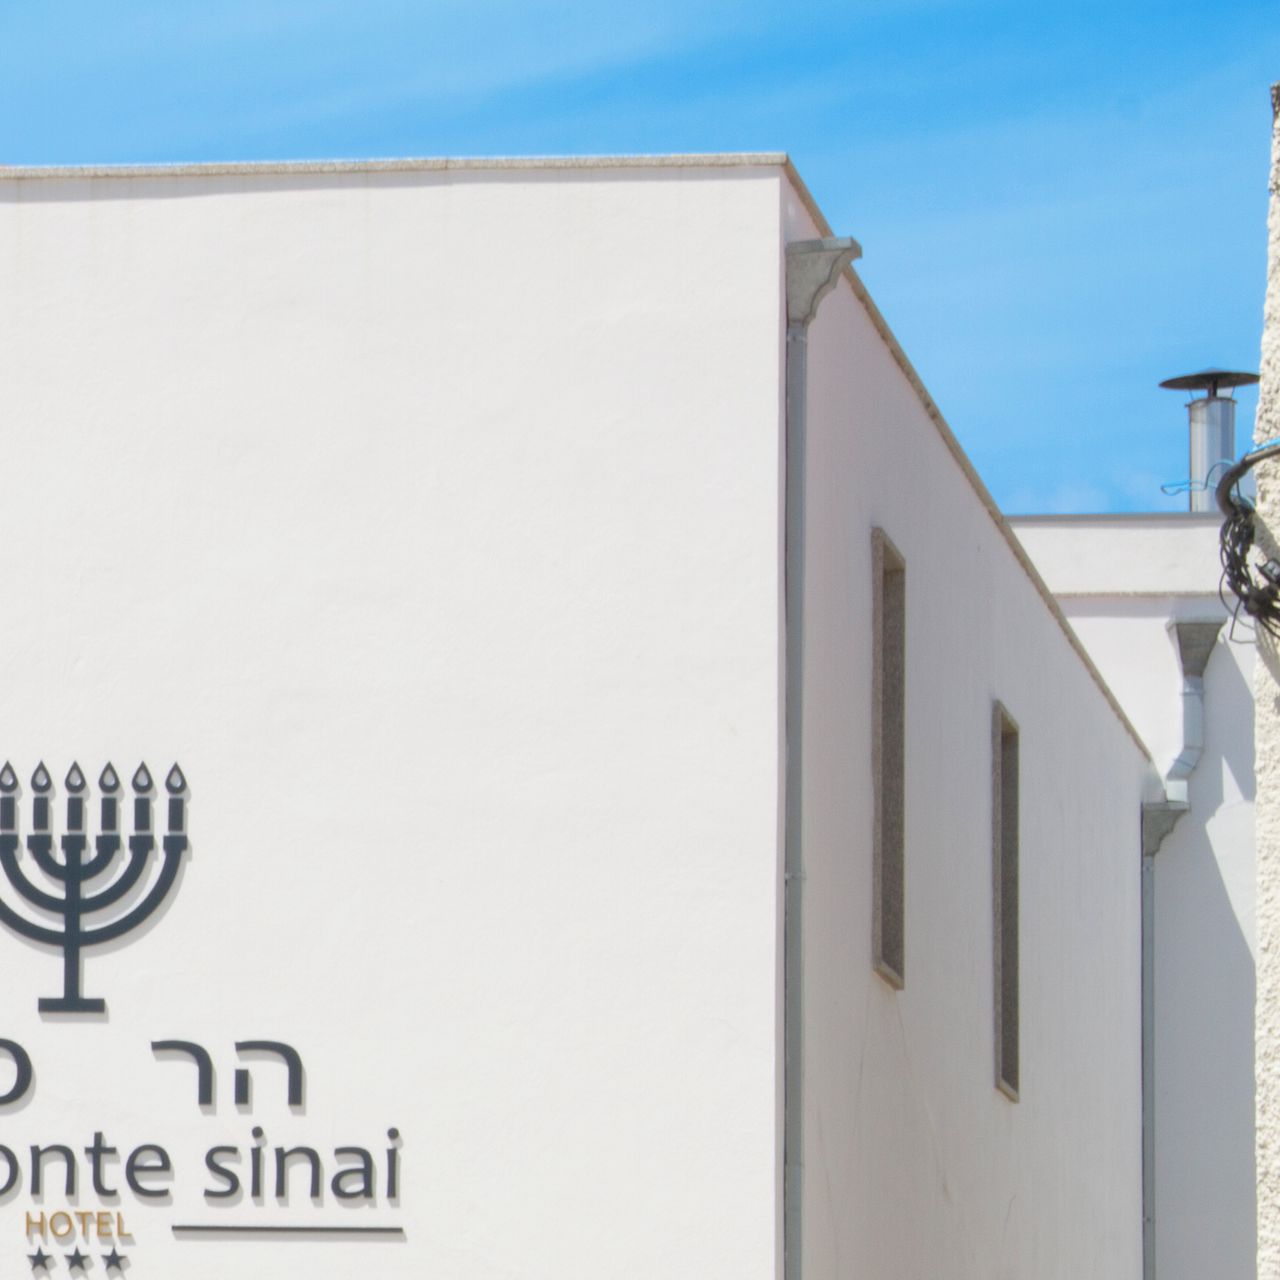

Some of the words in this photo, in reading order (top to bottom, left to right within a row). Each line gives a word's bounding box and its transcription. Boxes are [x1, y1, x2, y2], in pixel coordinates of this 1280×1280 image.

[151, 1040, 304, 1106] הר
[203, 1126, 400, 1200] sinai
[25, 1210, 132, 1238] HOTEL
